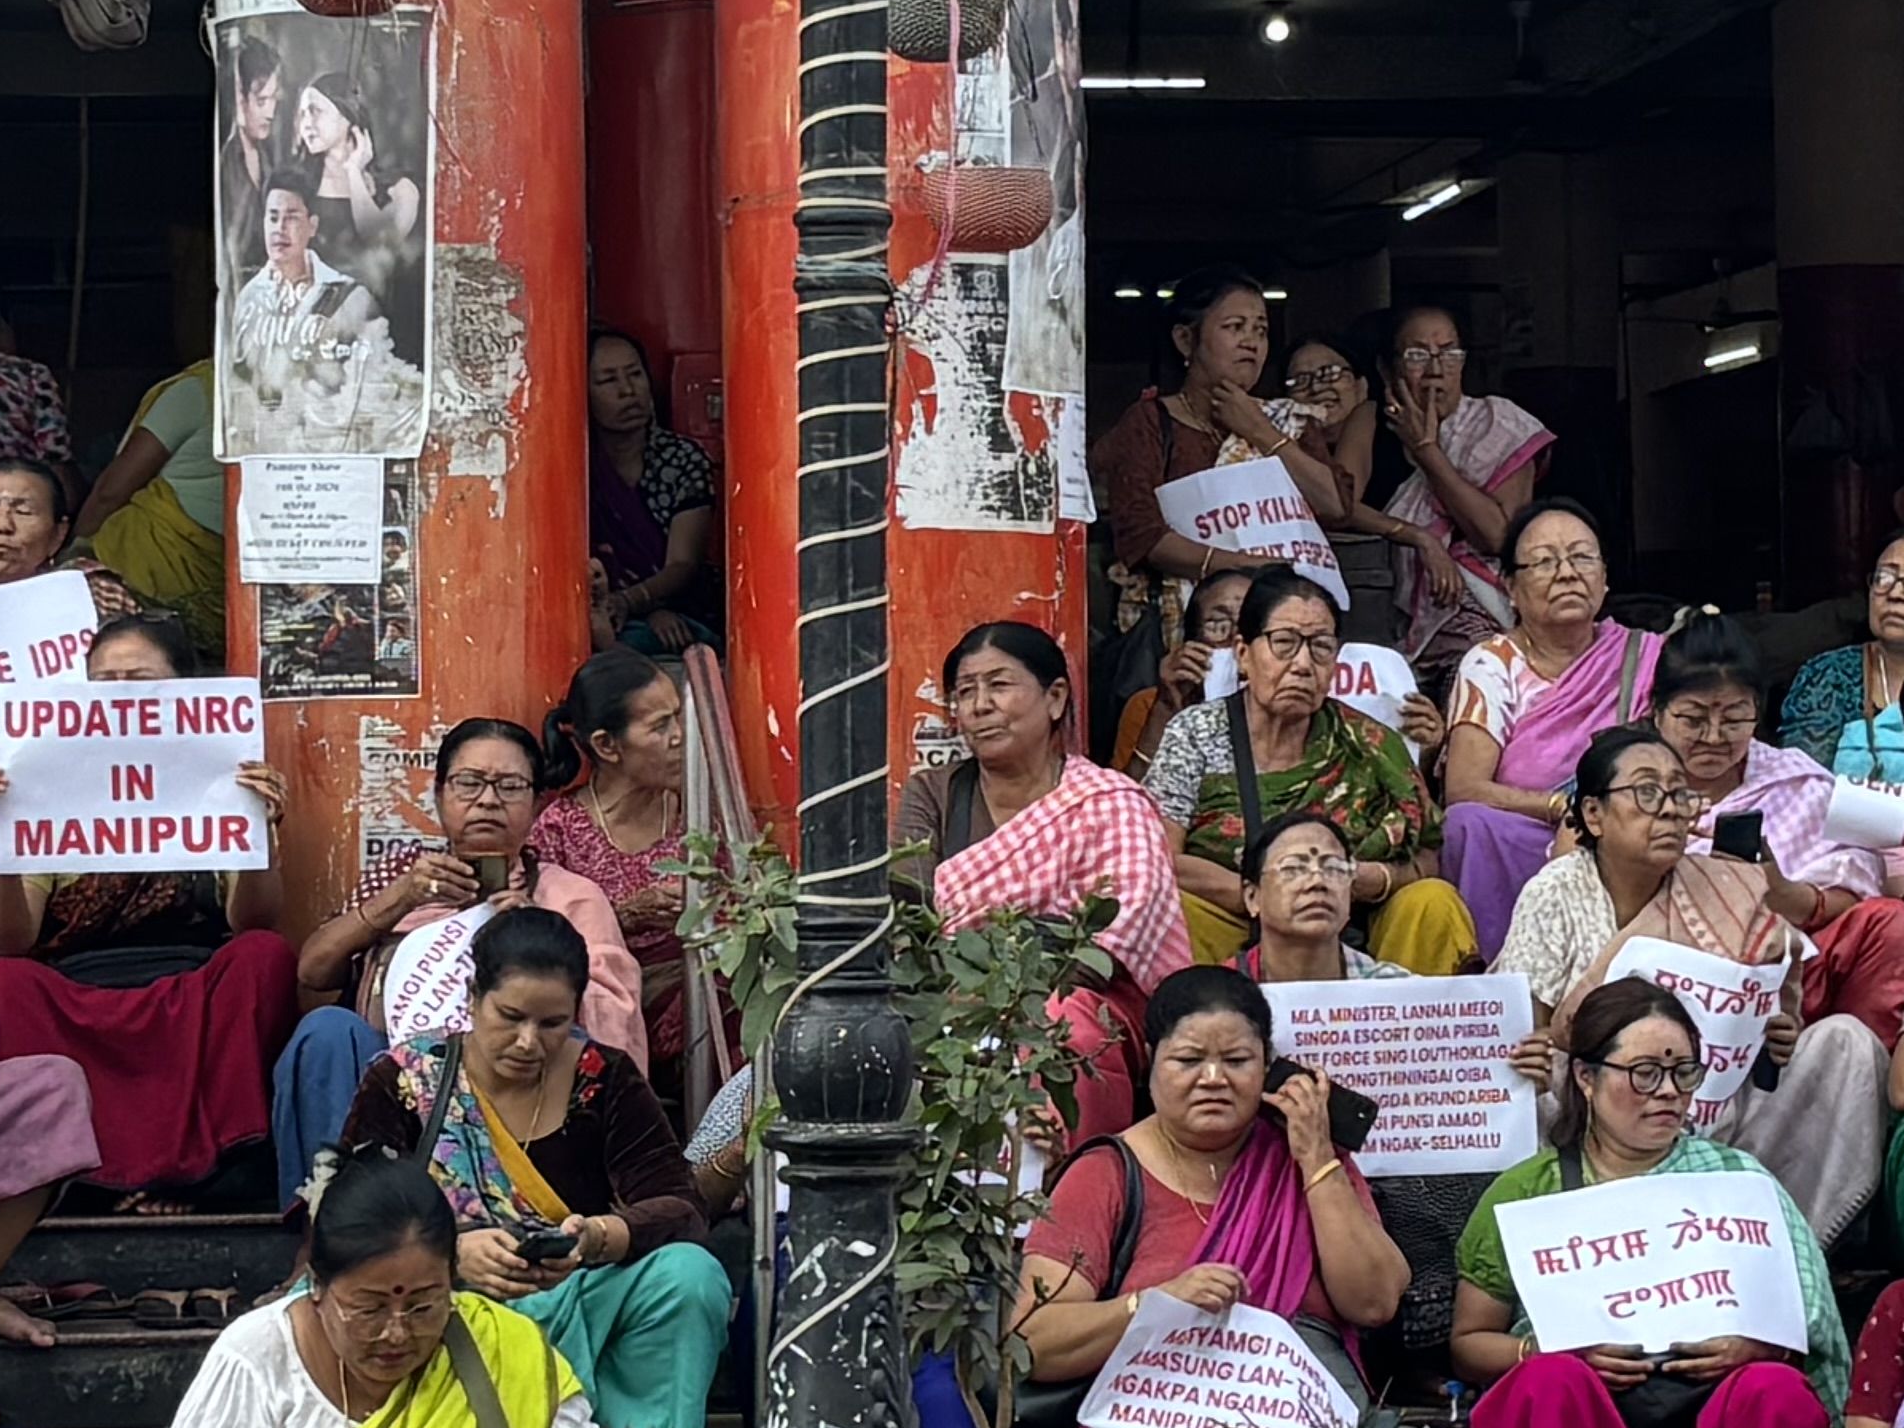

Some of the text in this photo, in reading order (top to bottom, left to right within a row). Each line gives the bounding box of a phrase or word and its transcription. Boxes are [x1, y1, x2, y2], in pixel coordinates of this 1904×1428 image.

[1195, 501, 1251, 540] STOP
[4, 695, 255, 738] UPDATE NRC
[110, 764, 154, 801] IN
[14, 815, 251, 857] MANIPUR
[1354, 1026, 1412, 1045] ESCORT
[1322, 1050, 1371, 1069] FORCE
[1374, 1047, 1408, 1065] SING
